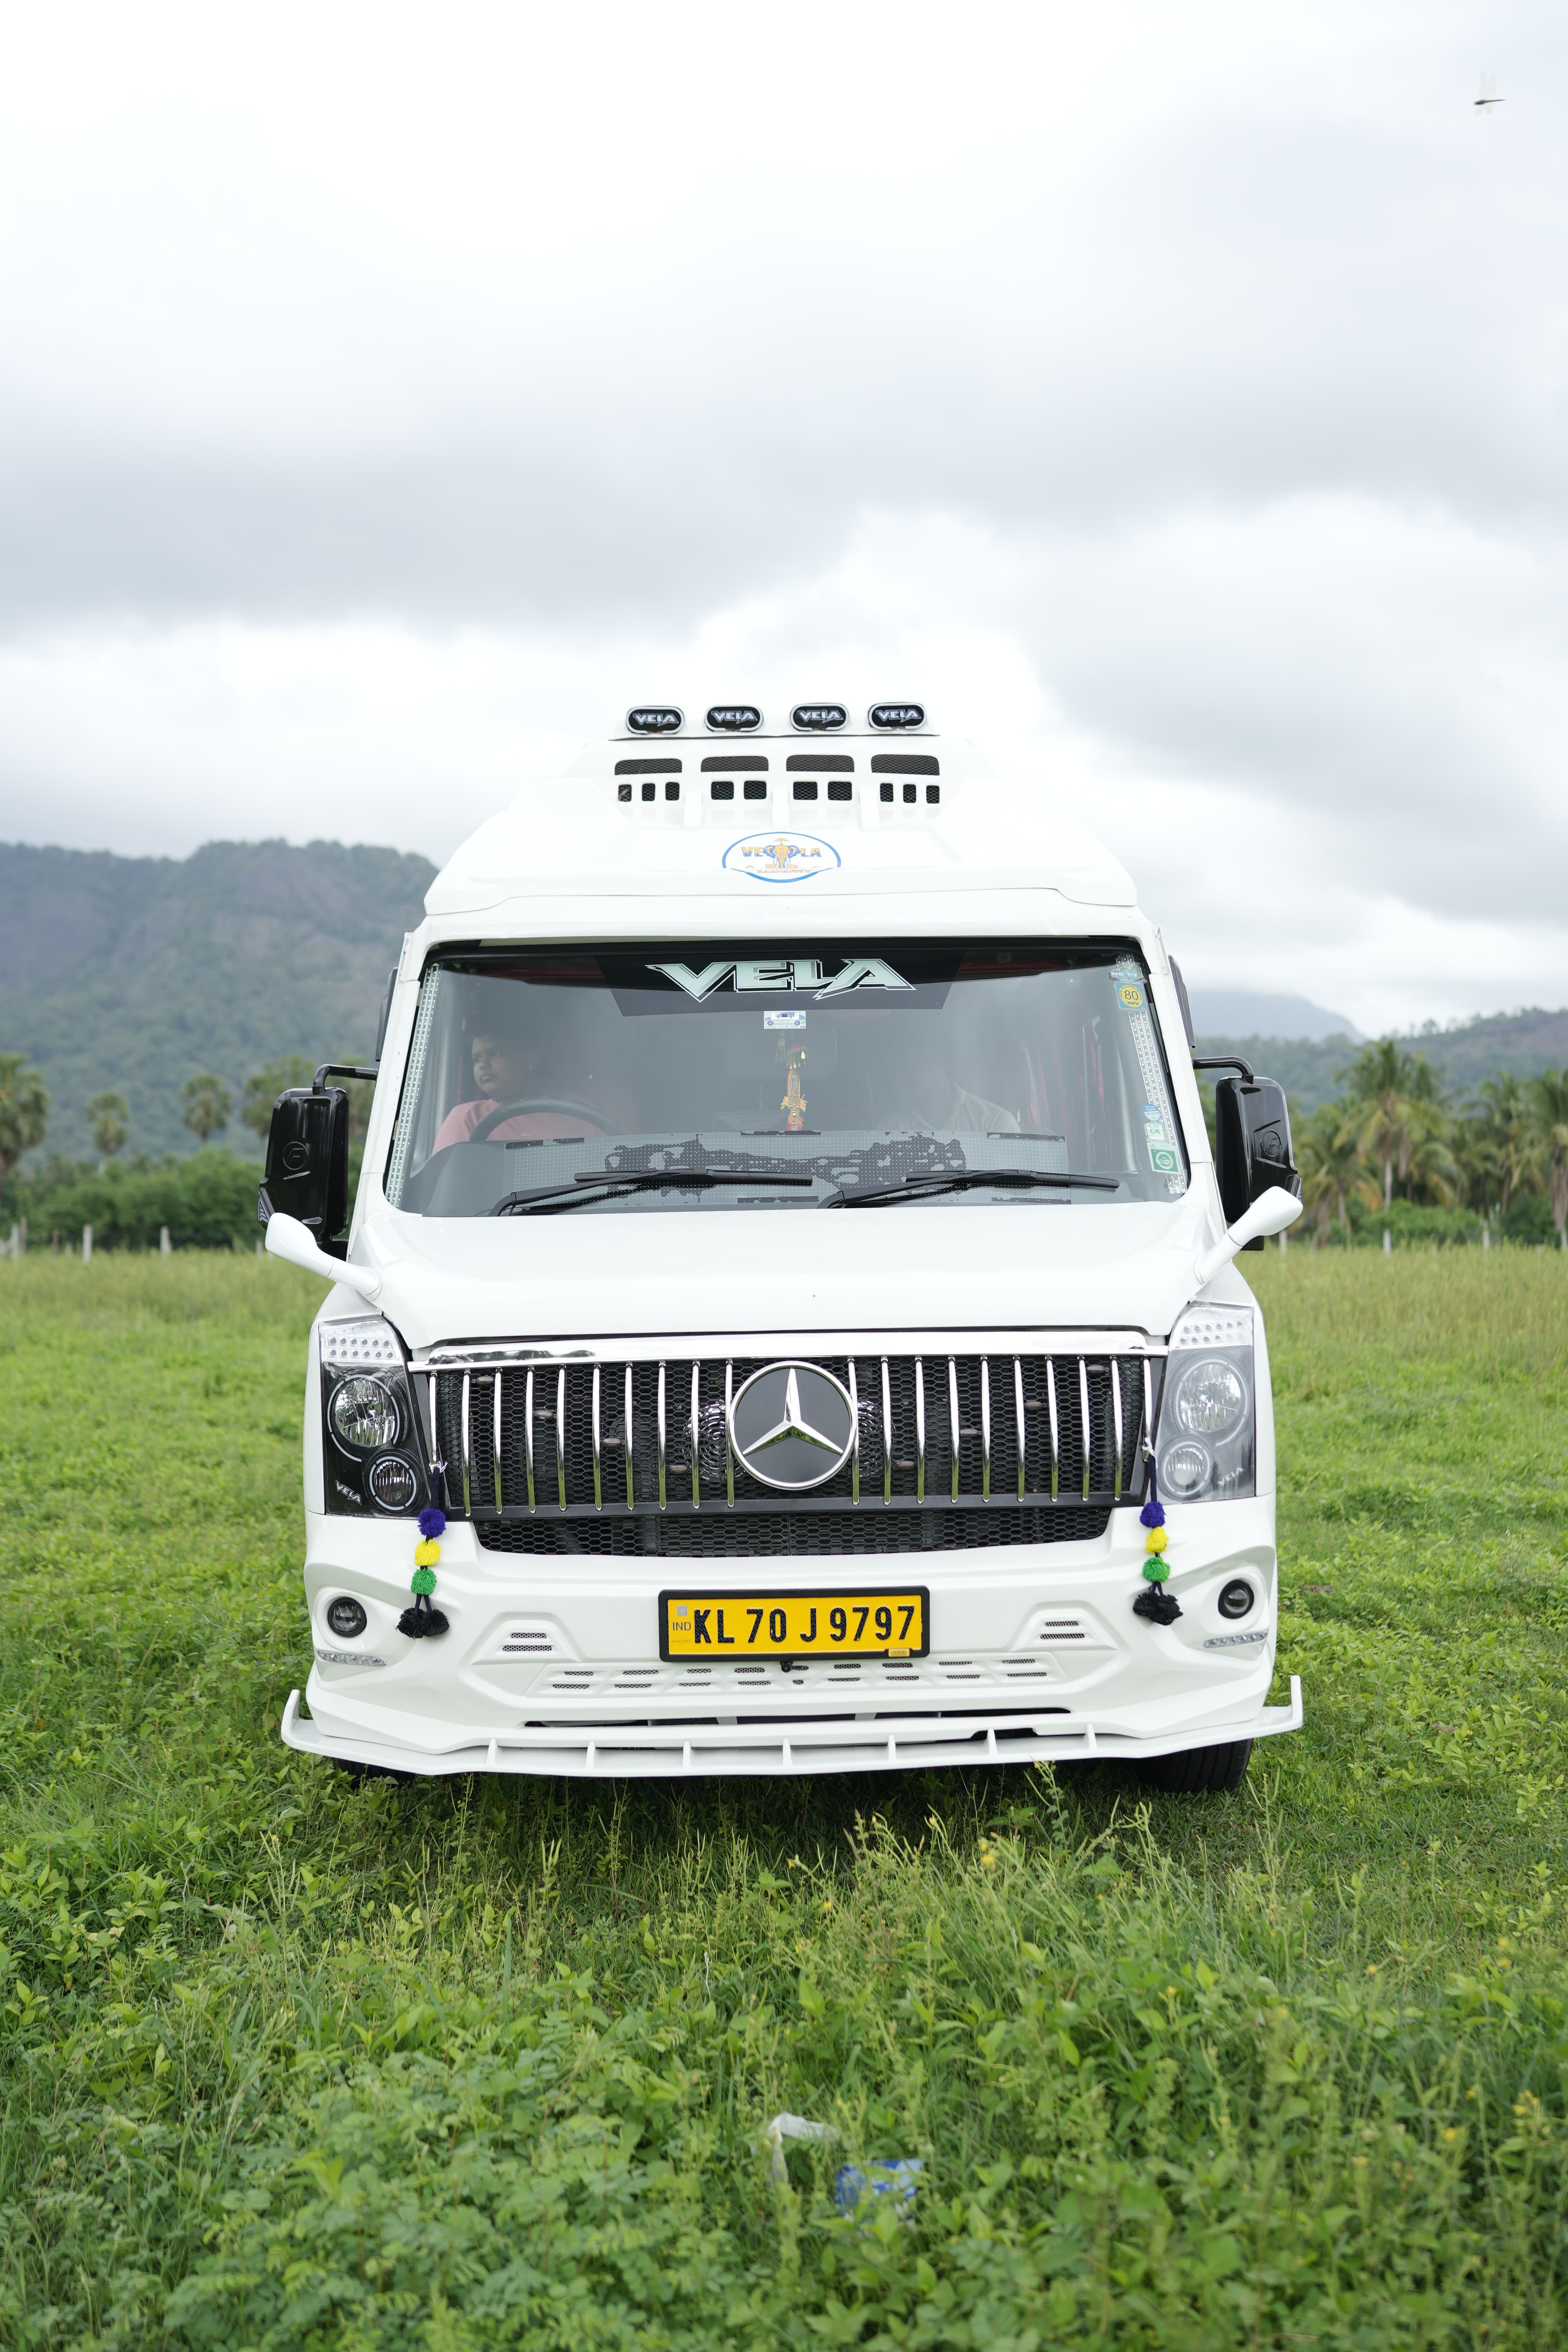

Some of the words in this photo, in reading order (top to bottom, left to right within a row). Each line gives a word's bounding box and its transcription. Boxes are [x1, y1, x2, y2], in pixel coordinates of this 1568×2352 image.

[633, 713, 679, 727] VELA
[711, 710, 758, 724] VELA
[797, 709, 844, 723] VELA
[875, 709, 922, 723] VELA
[644, 958, 916, 1002] VELA
[1124, 990, 1138, 1000] 80
[1216, 1466, 1247, 1487] VELA
[334, 1480, 362, 1505] VELA
[673, 1621, 691, 1630] IND
[694, 1609, 735, 1644] KL
[746, 1608, 786, 1643] 70
[800, 1608, 817, 1642] J
[830, 1606, 915, 1642] 9797
